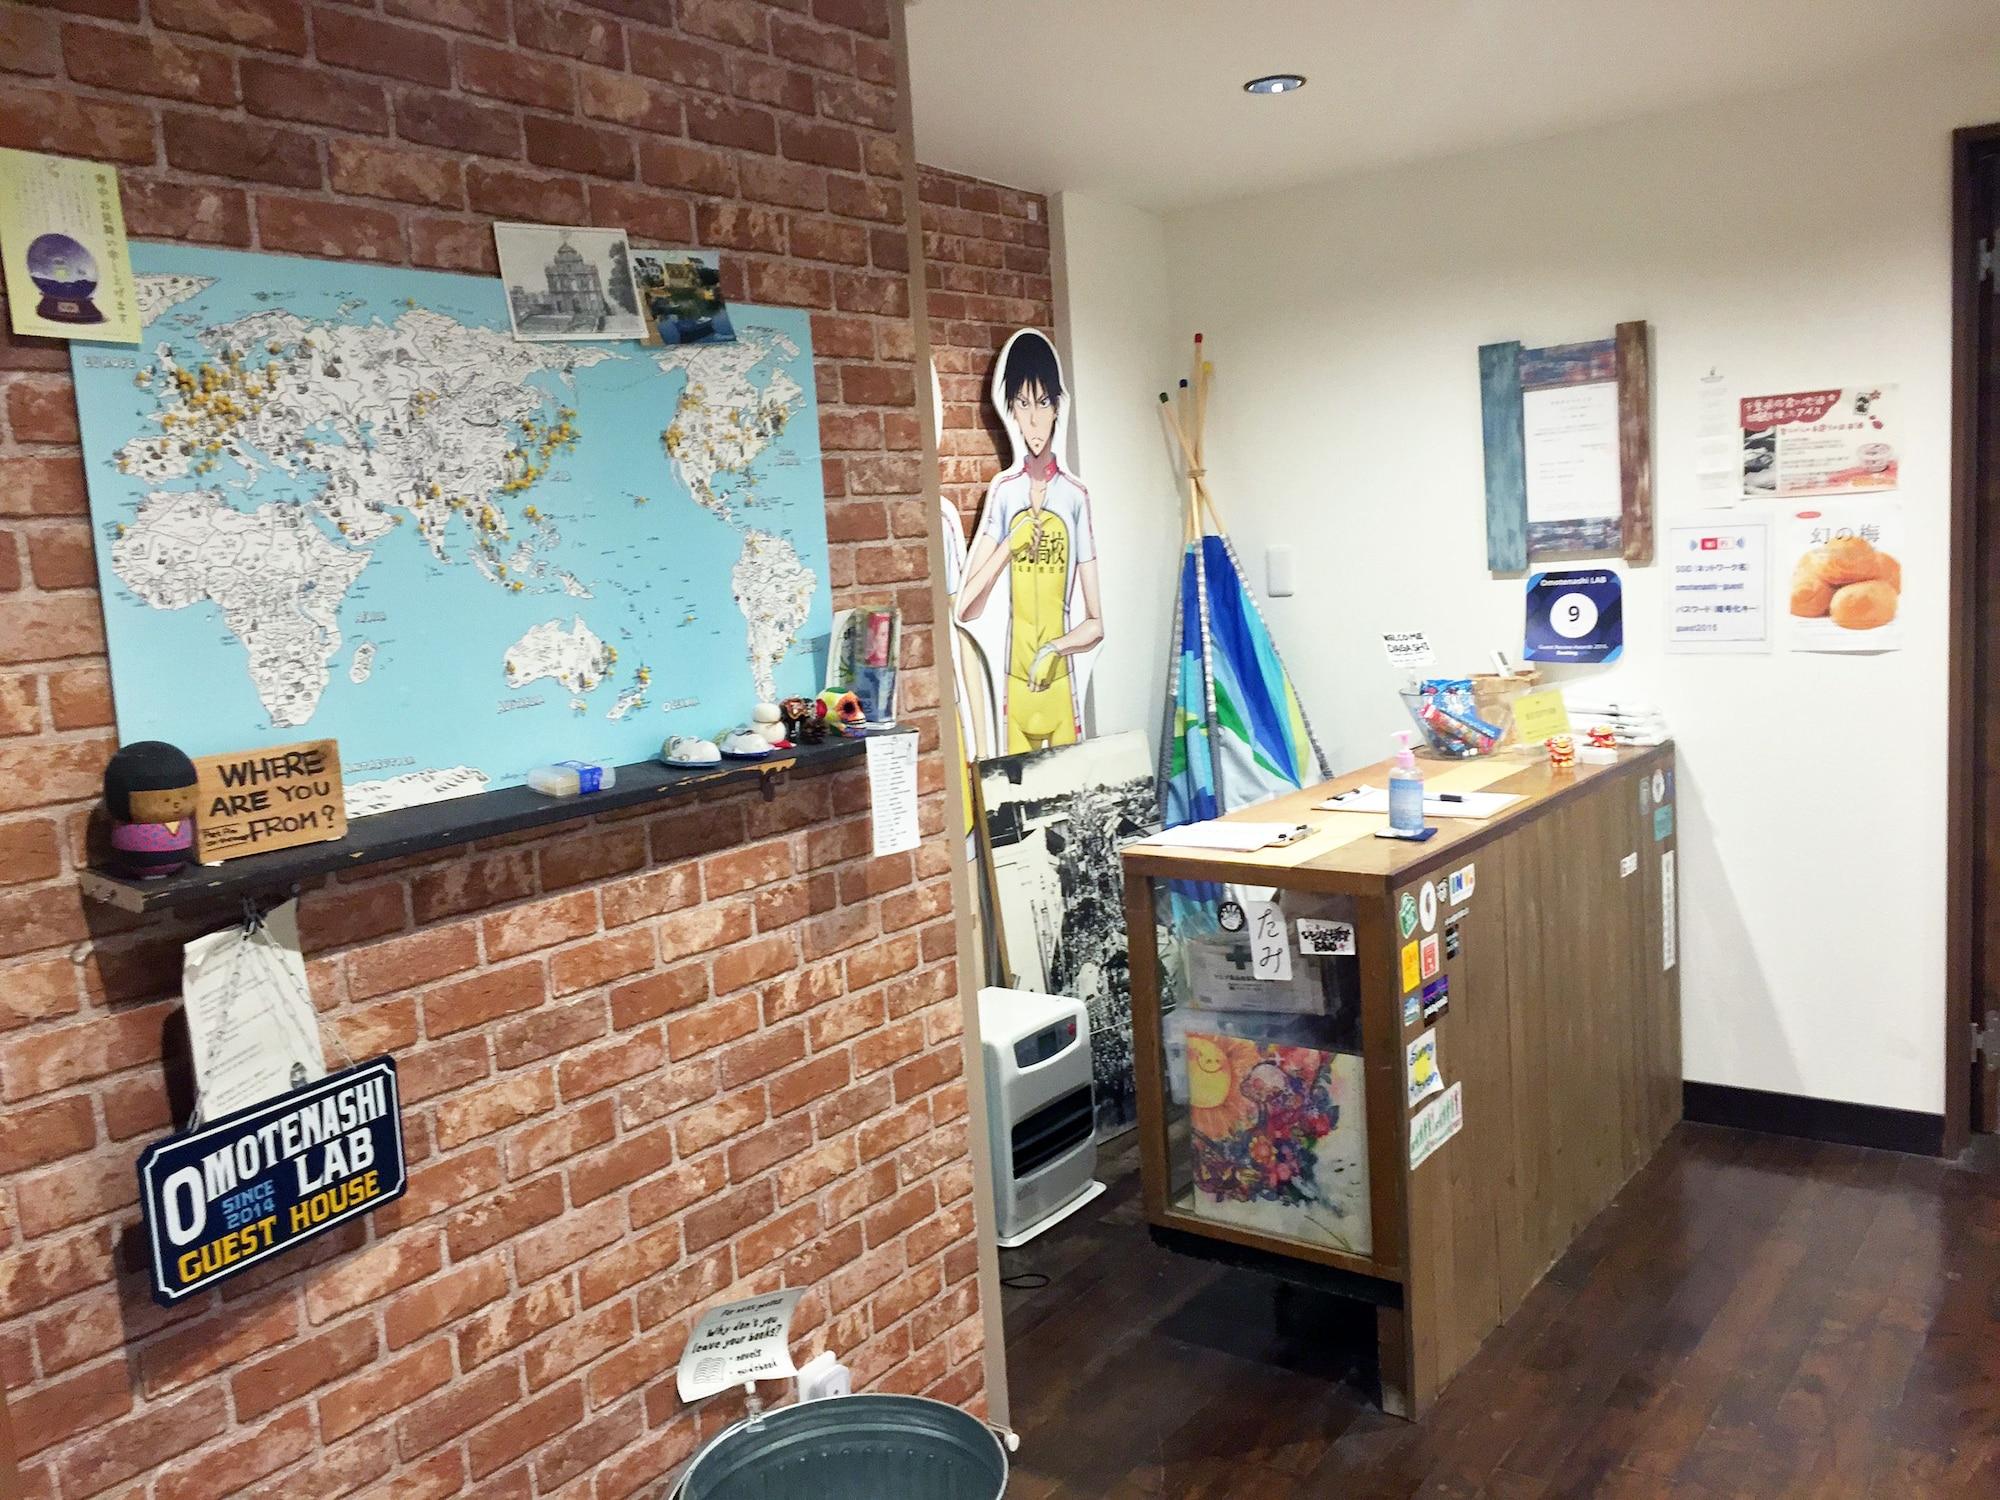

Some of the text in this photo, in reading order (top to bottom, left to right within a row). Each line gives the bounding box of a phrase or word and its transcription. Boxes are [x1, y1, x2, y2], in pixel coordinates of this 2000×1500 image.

[1568, 605, 1580, 622] 9
[1383, 632, 1424, 642] WELCOME
[217, 749, 327, 788] WHERE
[209, 781, 330, 818] ARE YOU
[163, 1076, 388, 1246] OMOTENASHI
[294, 1127, 375, 1197] LAB
[222, 1179, 276, 1216] SINCE
[226, 1197, 276, 1230] 2014
[177, 1169, 381, 1283] GUEST HOUSE
[692, 1324, 782, 1354] leave your books?
[708, 1323, 729, 1337] Why
[761, 1316, 778, 1327] you
